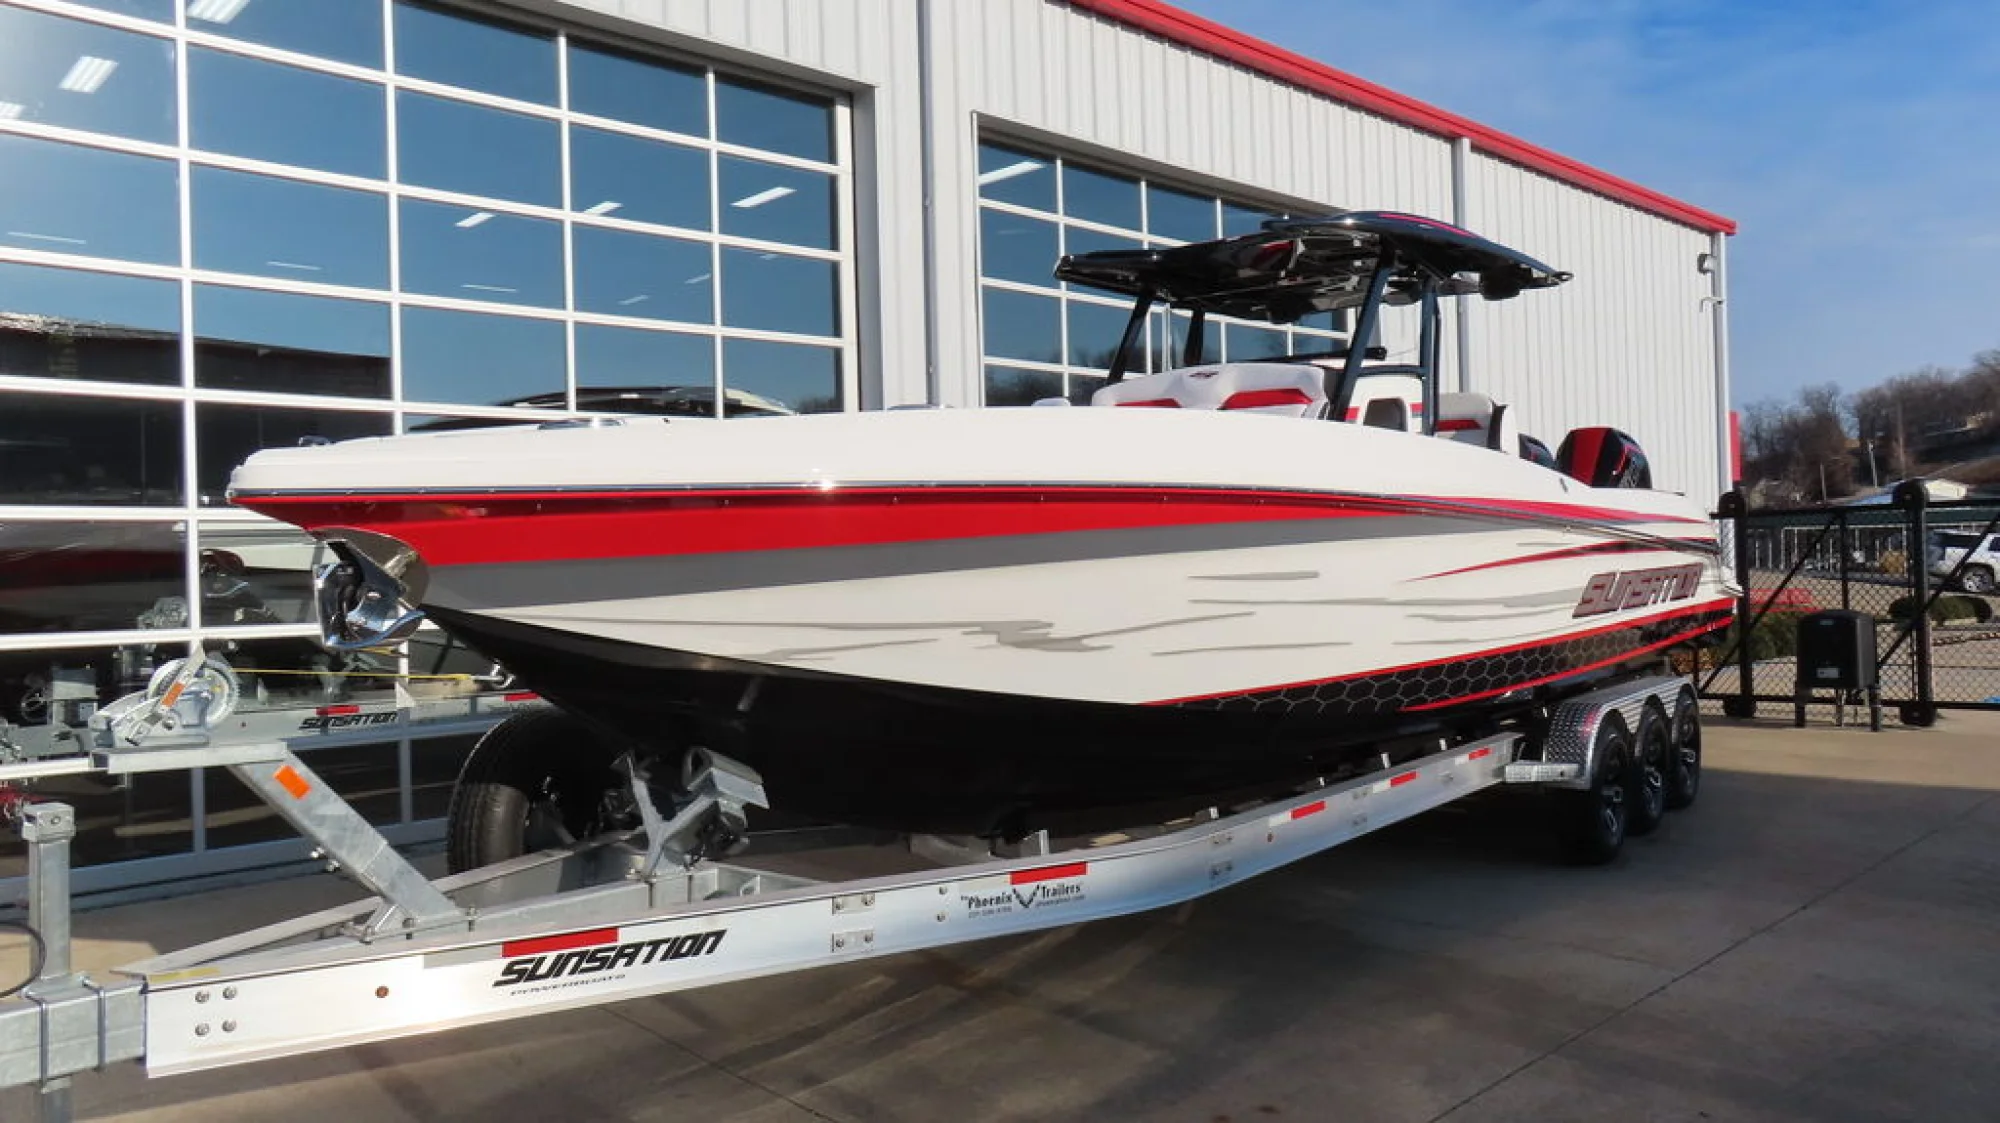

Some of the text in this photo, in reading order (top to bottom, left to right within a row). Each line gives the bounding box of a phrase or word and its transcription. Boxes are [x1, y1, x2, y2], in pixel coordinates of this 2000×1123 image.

[1572, 562, 1703, 619] SUNSATION
[1041, 883, 1081, 899] Trailers
[492, 929, 727, 988] SUNSATION
